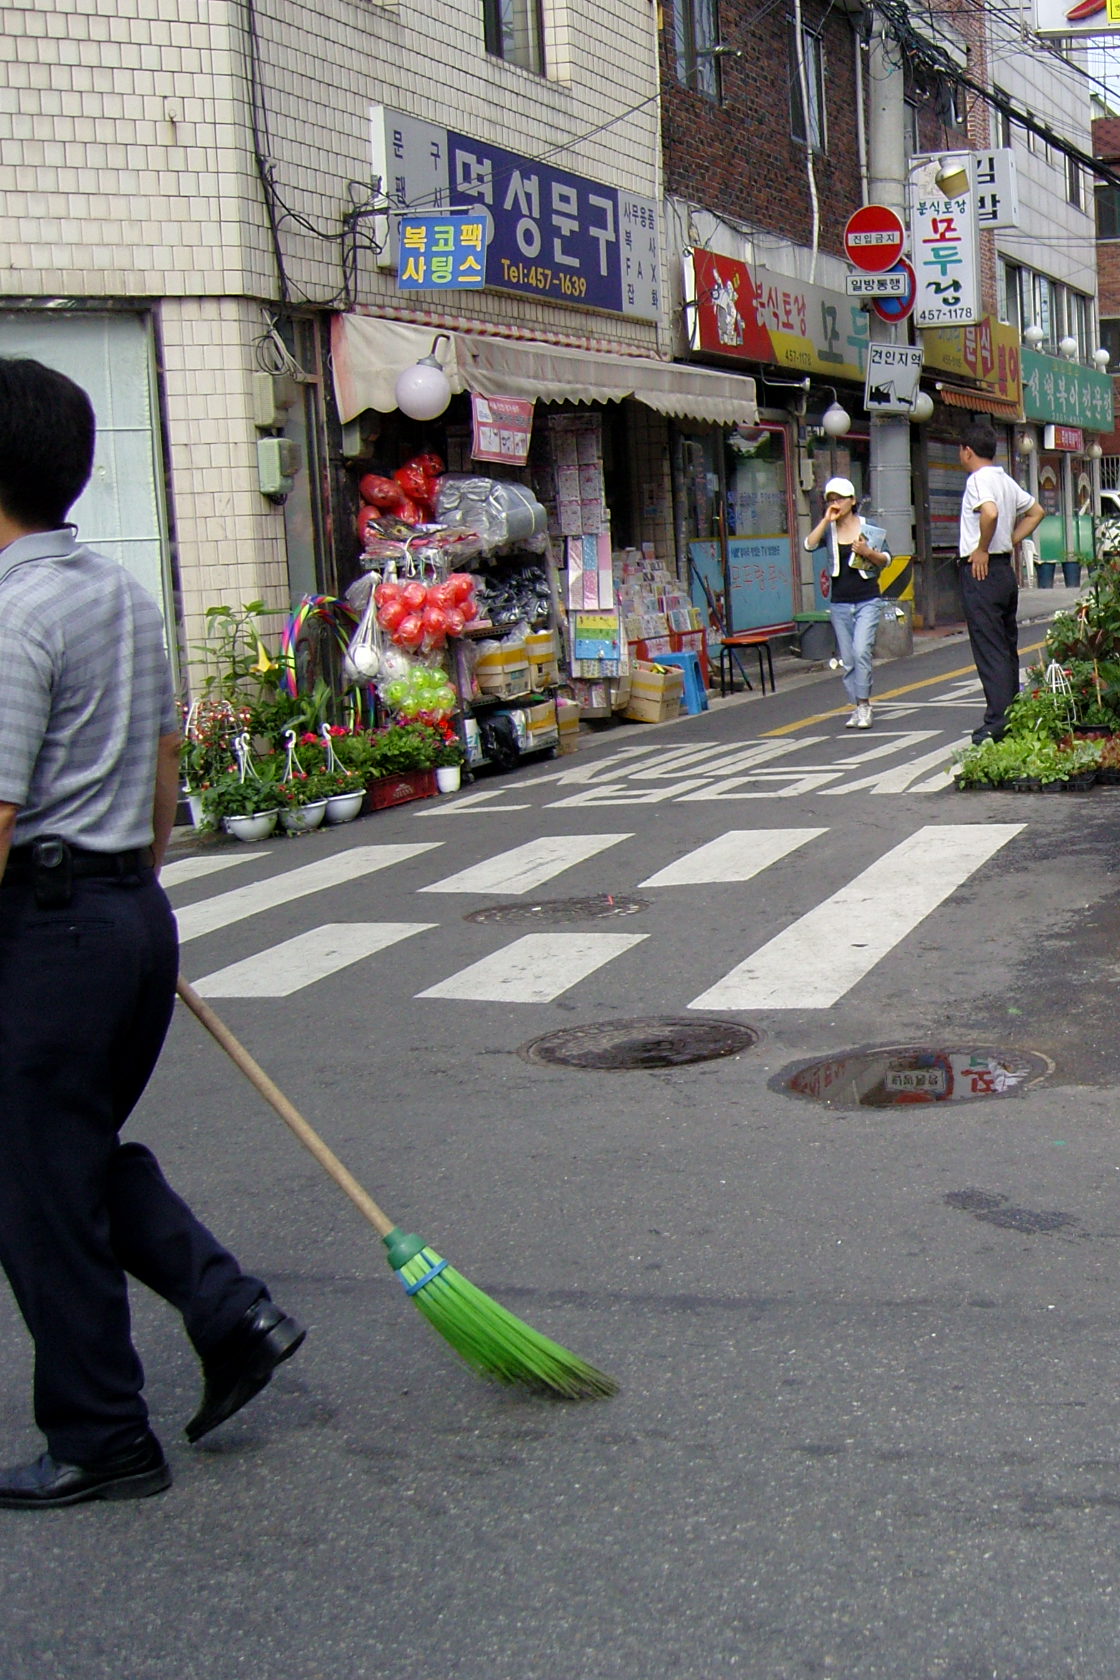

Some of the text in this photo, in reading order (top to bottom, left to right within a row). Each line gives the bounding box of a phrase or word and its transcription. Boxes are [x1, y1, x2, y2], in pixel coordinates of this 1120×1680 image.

[852, 234, 896, 246] 진입금지
[922, 217, 963, 307] 모두랑
[501, 257, 588, 298] Tel:457-1639
[851, 278, 901, 292] 일방통행
[919, 307, 973, 321] 457-1178
[871, 348, 922, 368] 견인지역
